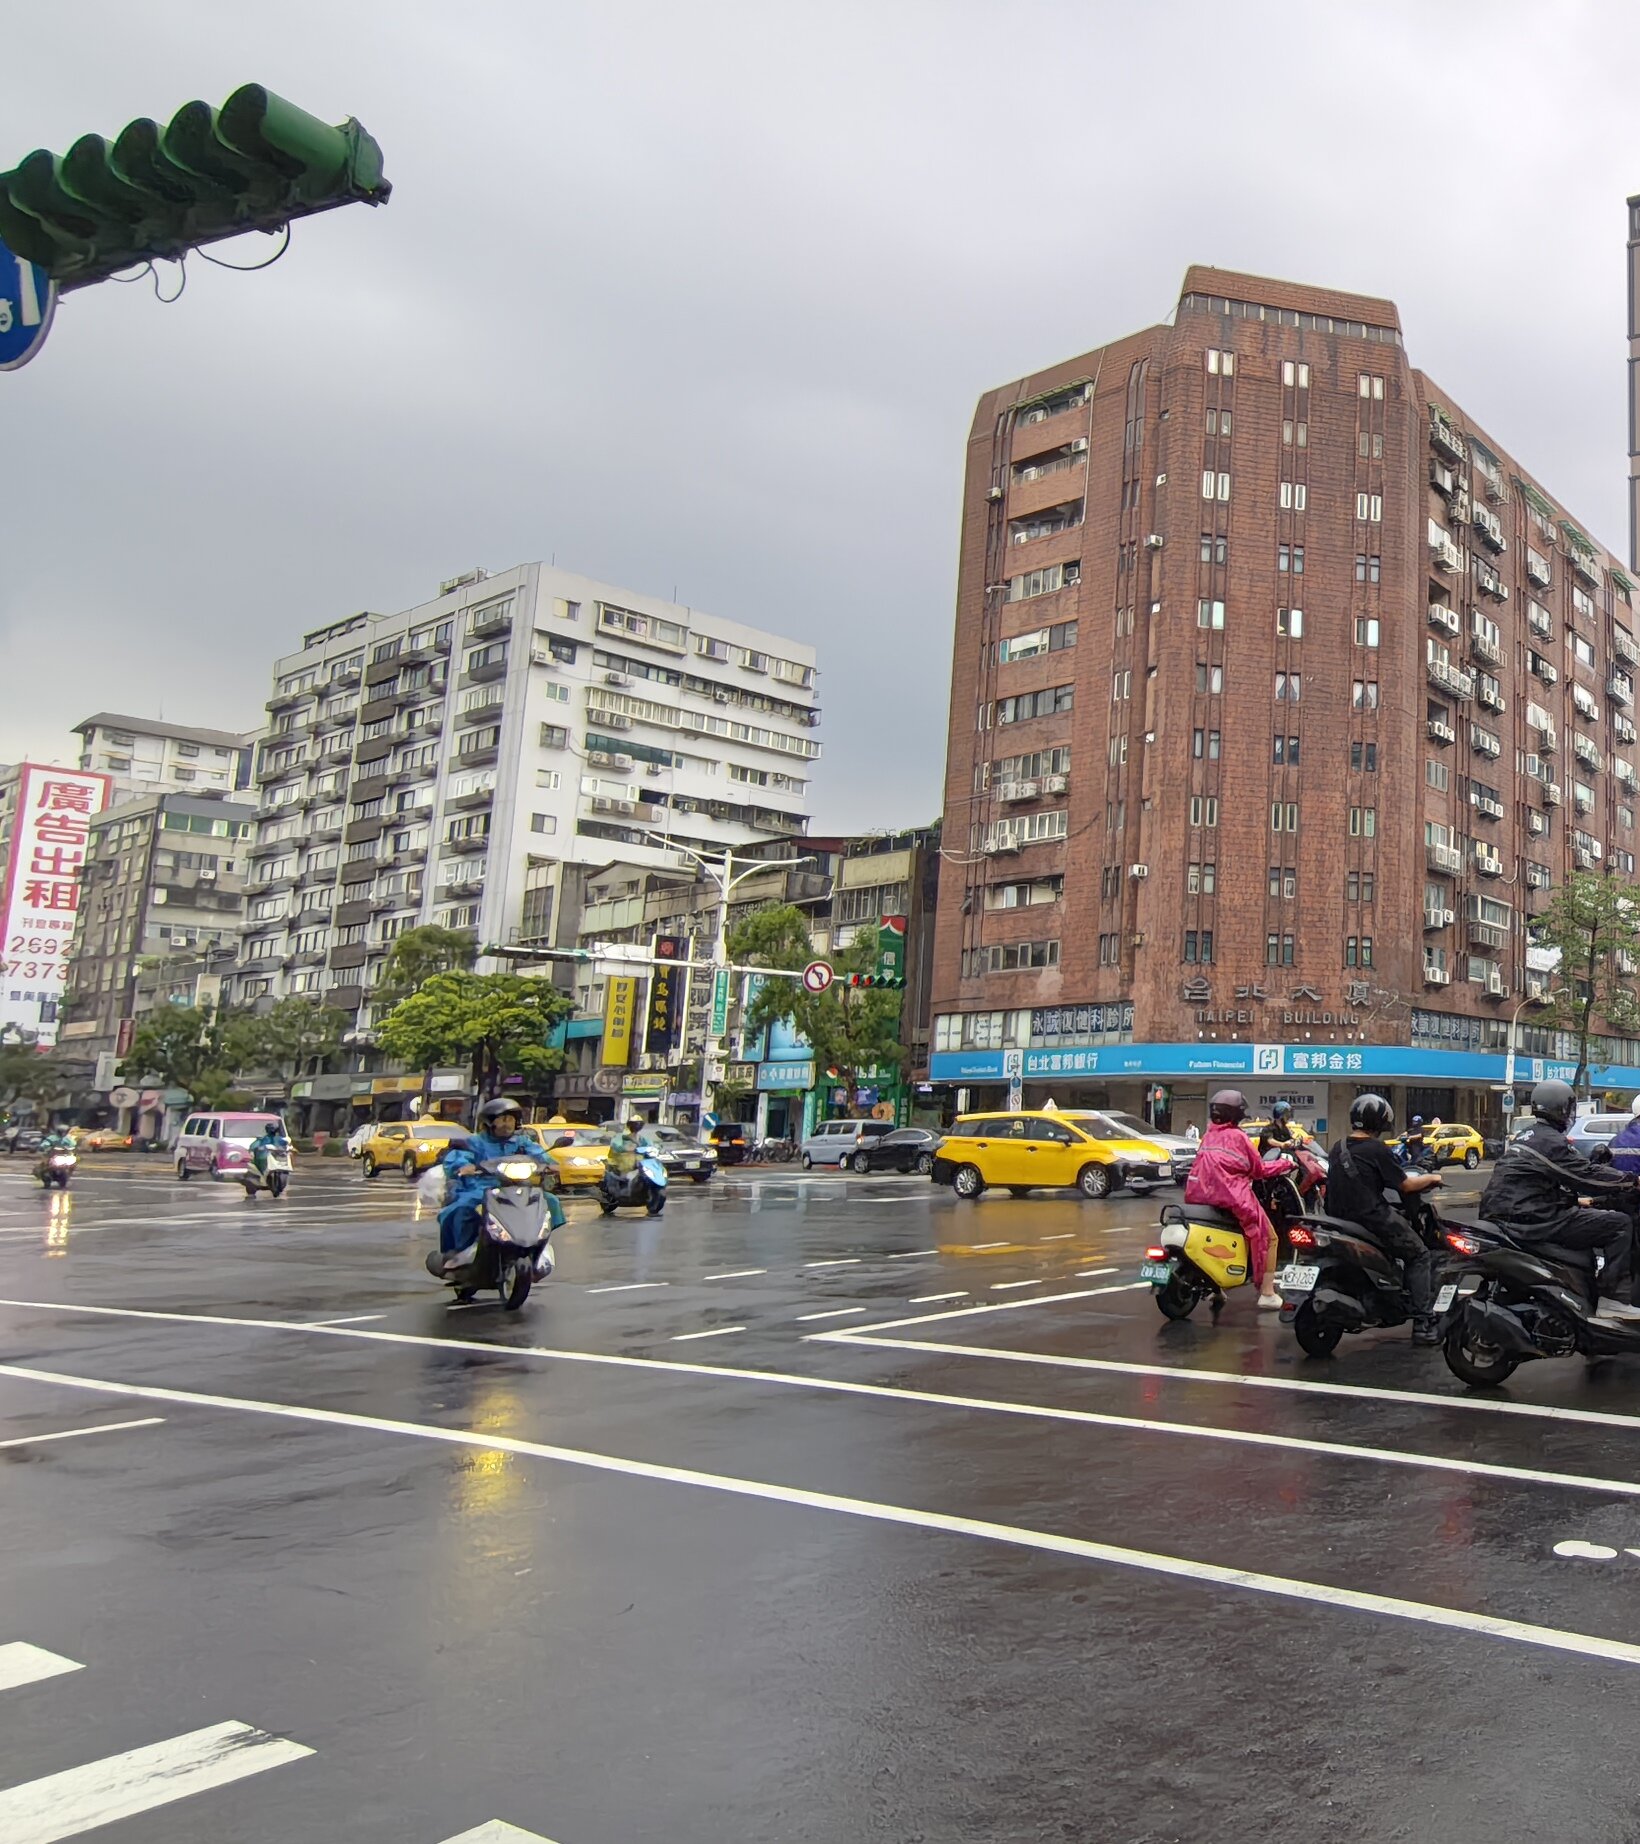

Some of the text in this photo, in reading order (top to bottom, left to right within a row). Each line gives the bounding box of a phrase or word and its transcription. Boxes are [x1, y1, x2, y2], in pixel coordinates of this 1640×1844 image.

[23, 780, 95, 911] 廣告出租
[8, 960, 69, 980] 7373
[1184, 977, 1371, 1006] 台北大廈
[1198, 1009, 1360, 1025] TAIPEI BUILDING
[1293, 1052, 1363, 1070] 富邦金控
